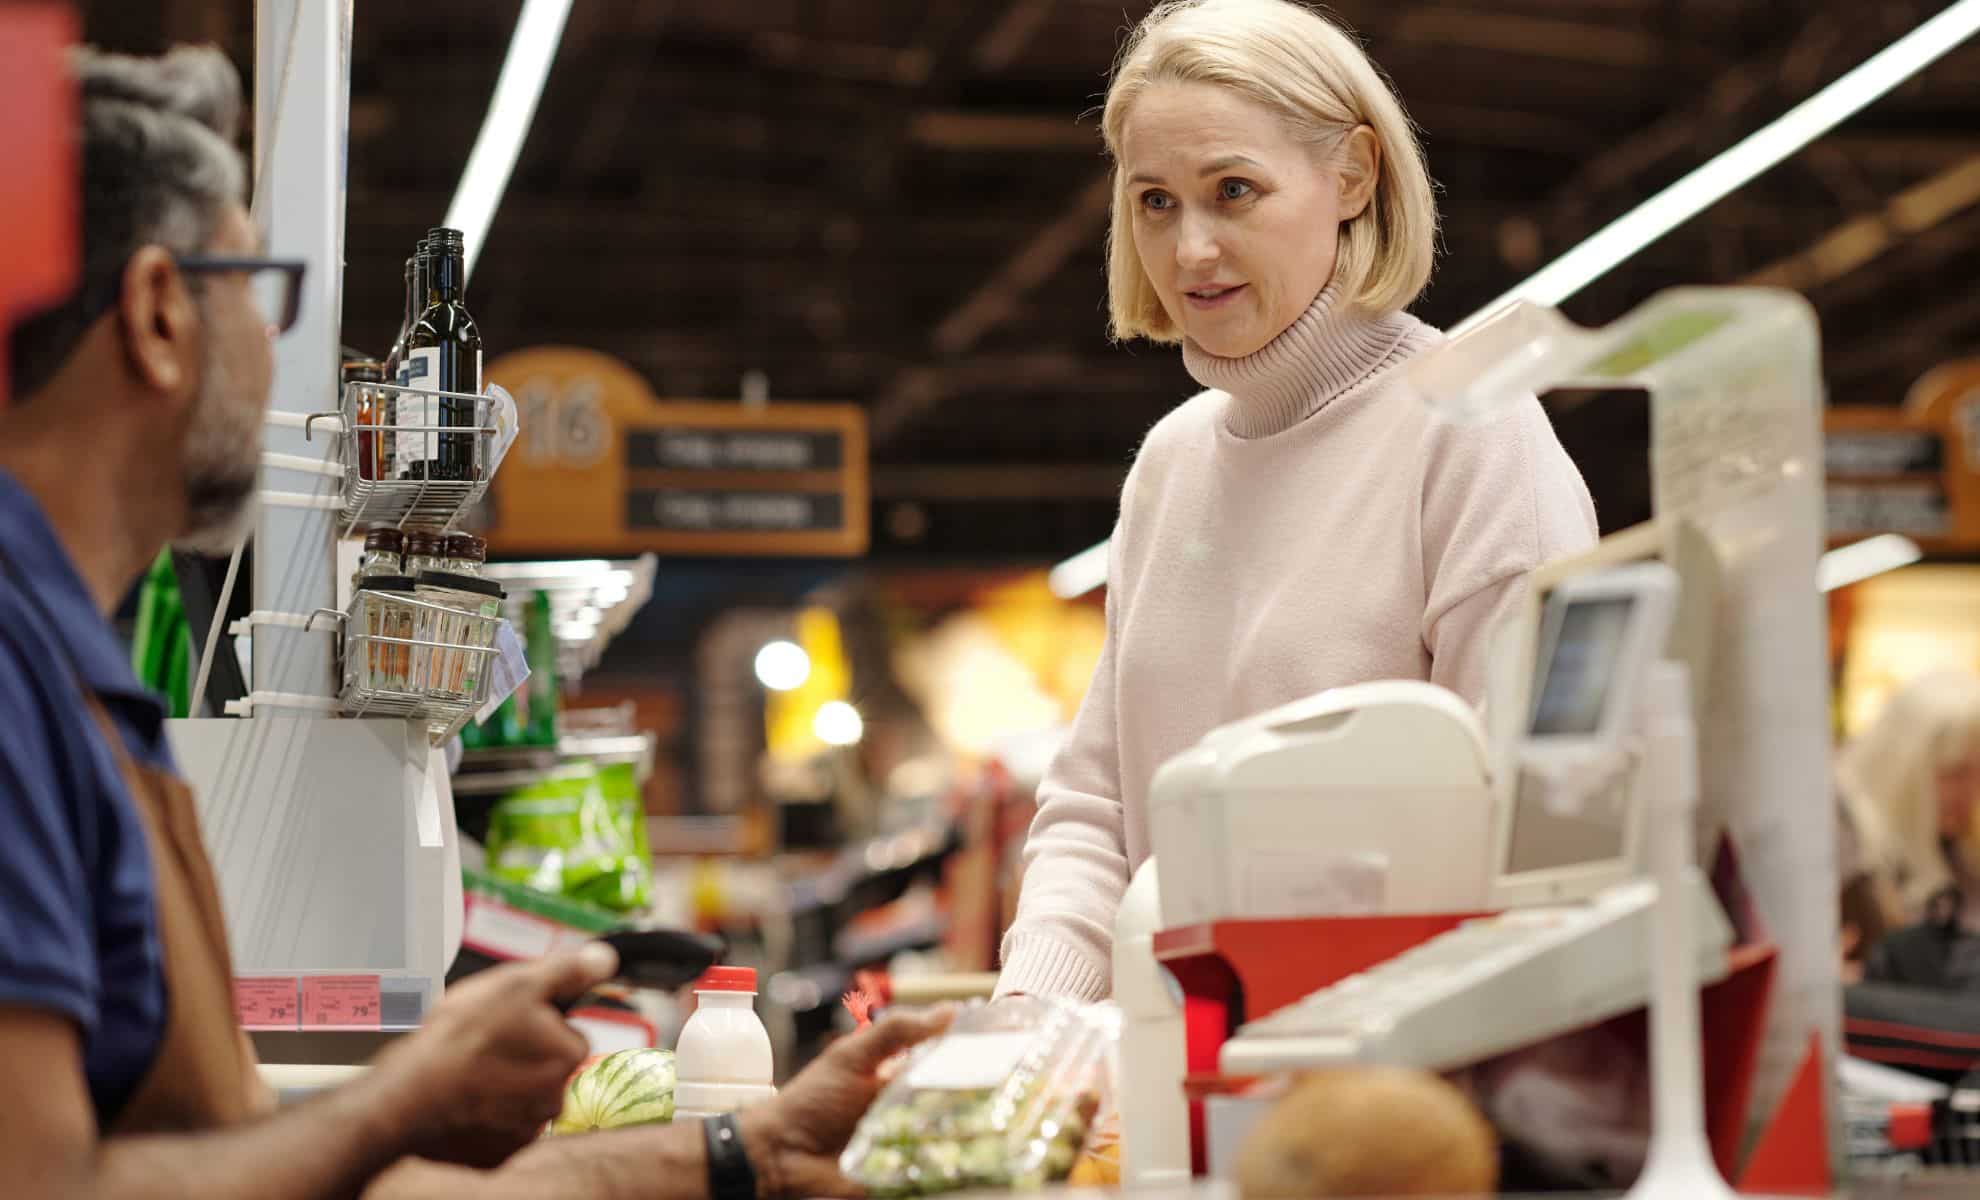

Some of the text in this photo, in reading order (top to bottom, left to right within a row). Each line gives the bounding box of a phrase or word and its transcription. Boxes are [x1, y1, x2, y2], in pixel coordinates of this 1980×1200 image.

[519, 377, 611, 465] 16
[270, 1008, 285, 1019] 79
[352, 1006, 368, 1017] 79
